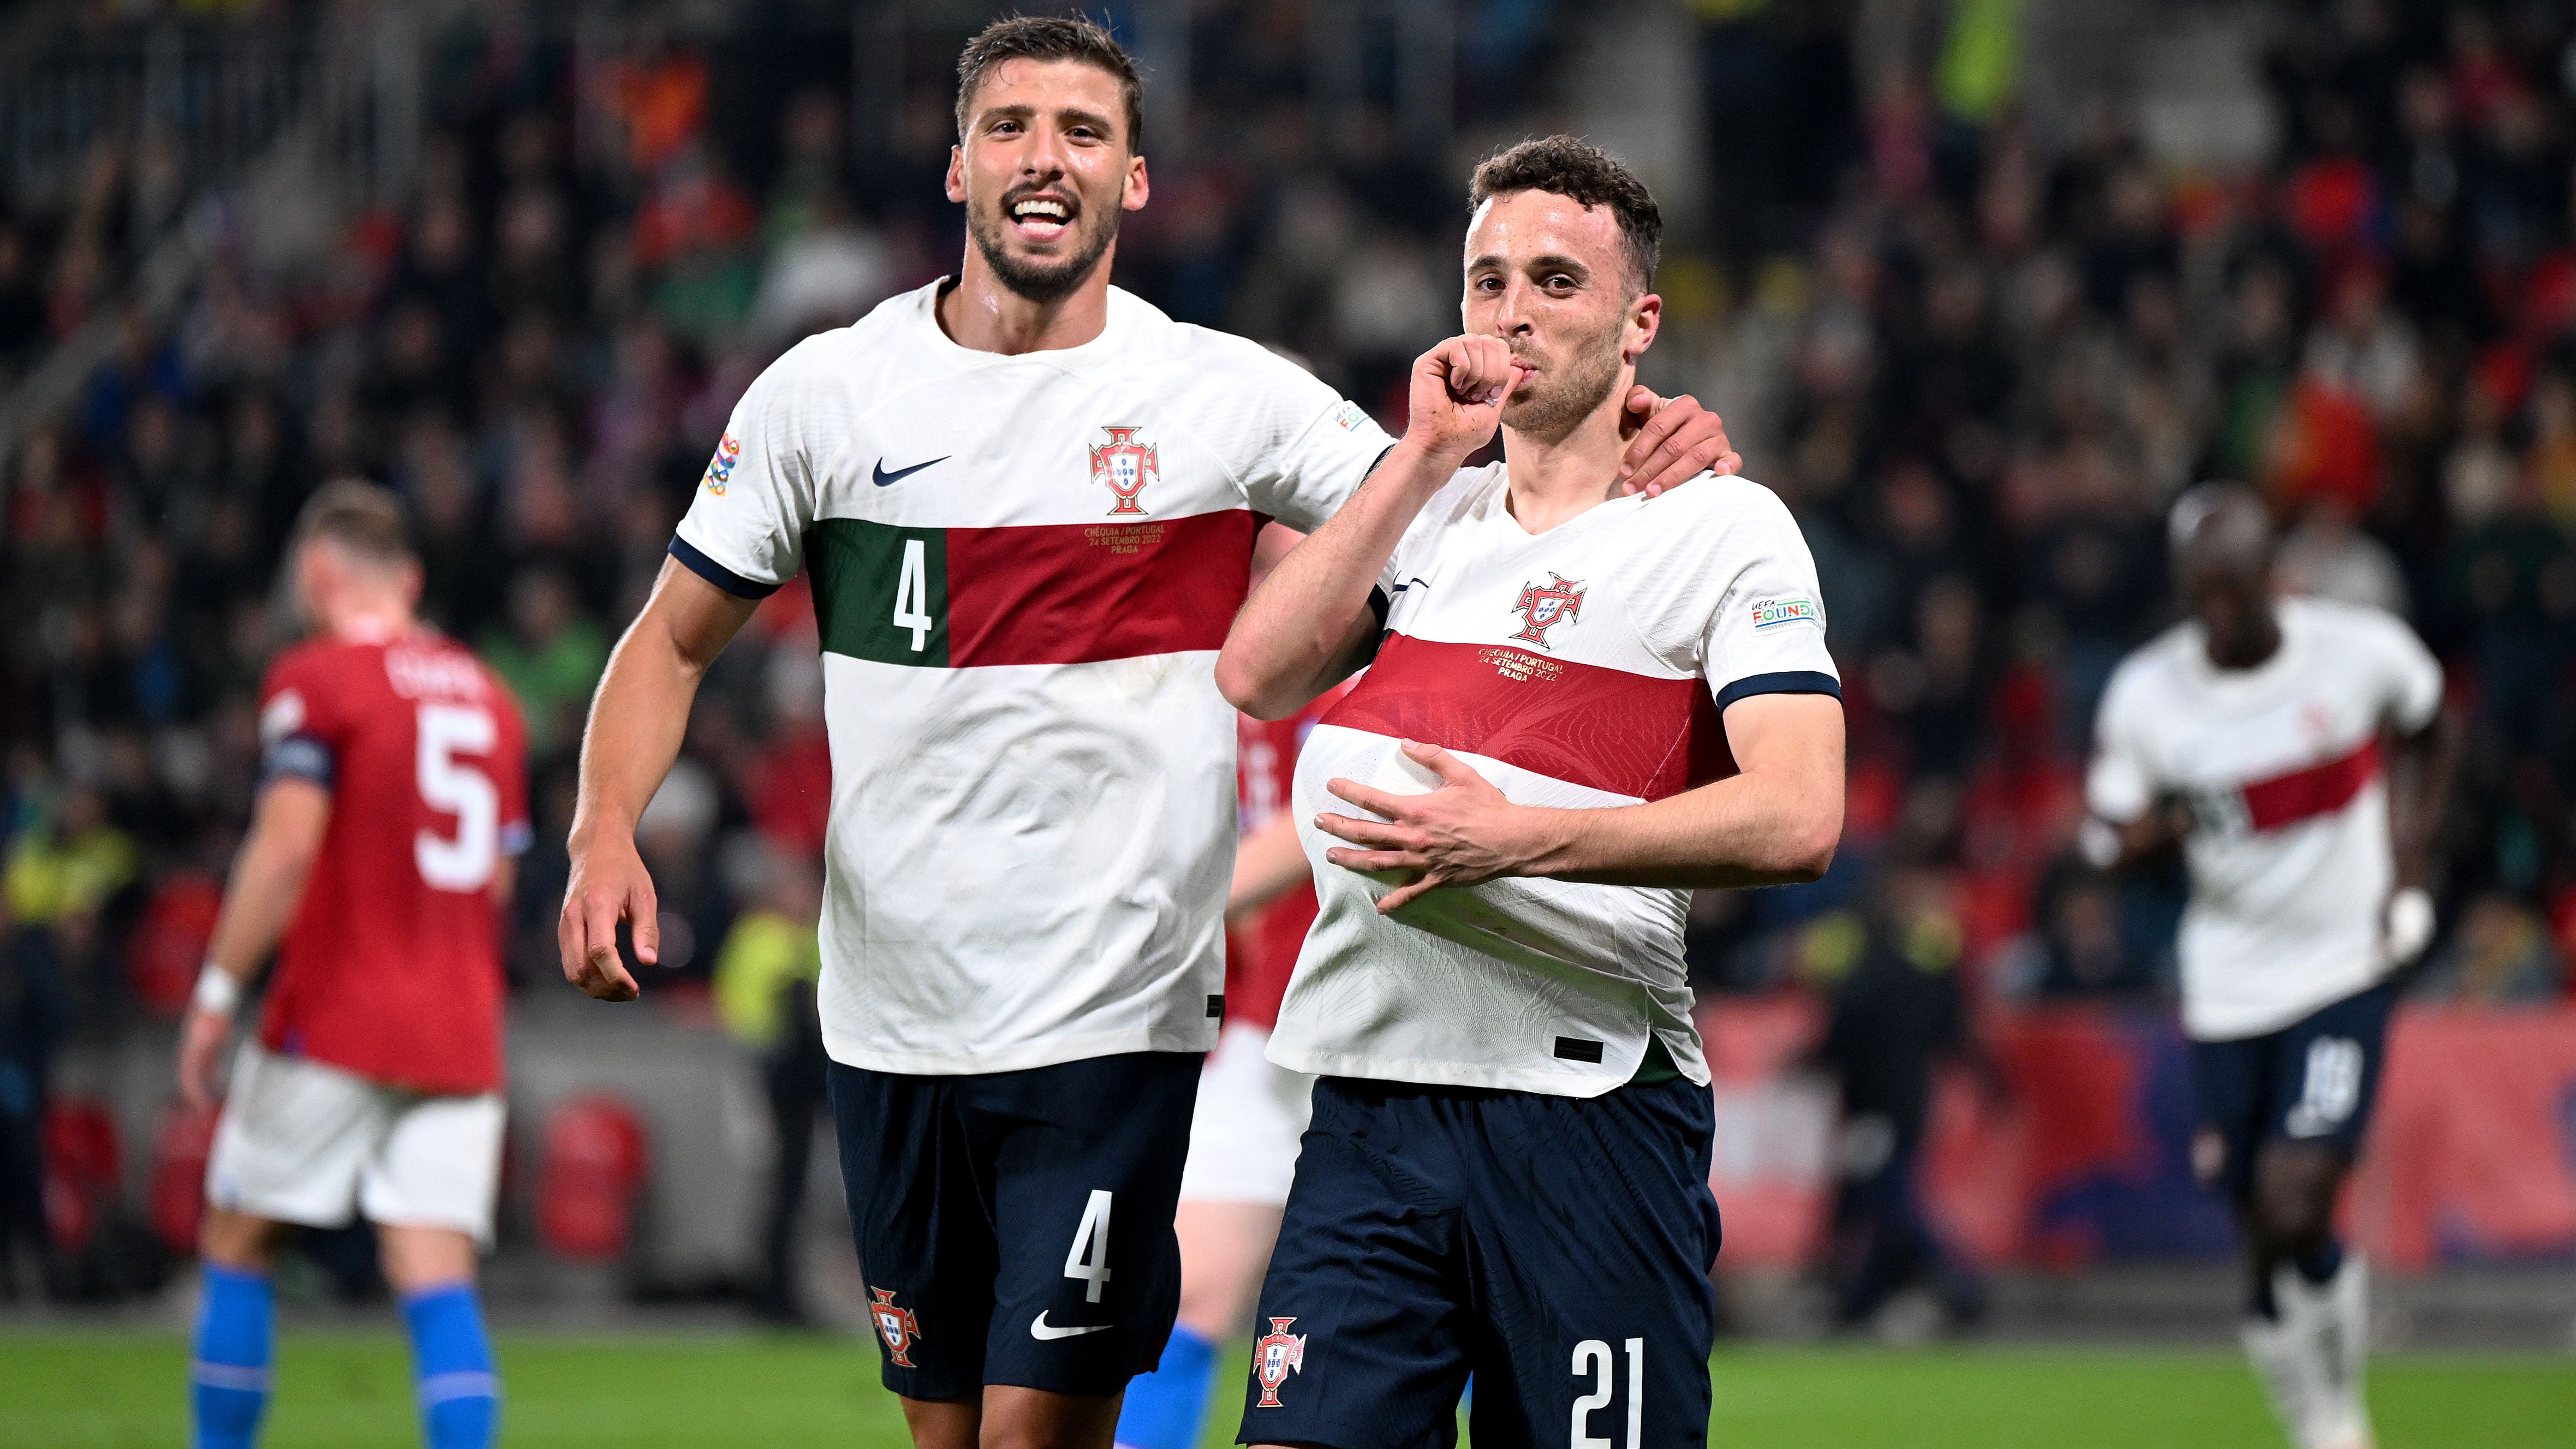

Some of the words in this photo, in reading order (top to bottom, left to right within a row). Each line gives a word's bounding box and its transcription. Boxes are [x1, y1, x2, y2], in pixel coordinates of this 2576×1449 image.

[1089, 538, 1098, 546] 24
[1100, 535, 1140, 546] SETEMBRO
[1142, 534, 1161, 544] 2022
[1125, 525, 1165, 535] PORTUGAL
[1111, 545, 1138, 554] PRAGA
[893, 539, 932, 652] 4
[1752, 600, 1775, 610] UEFA
[1491, 657, 1534, 675] SETEMBRO
[1535, 669, 1557, 682] 2022
[1520, 654, 1564, 674] PORTUGAL
[1498, 667, 1528, 682] PRAGA
[413, 702, 499, 894] 5
[1064, 1189, 1112, 1303] 4
[1571, 1337, 1643, 1449] 21
